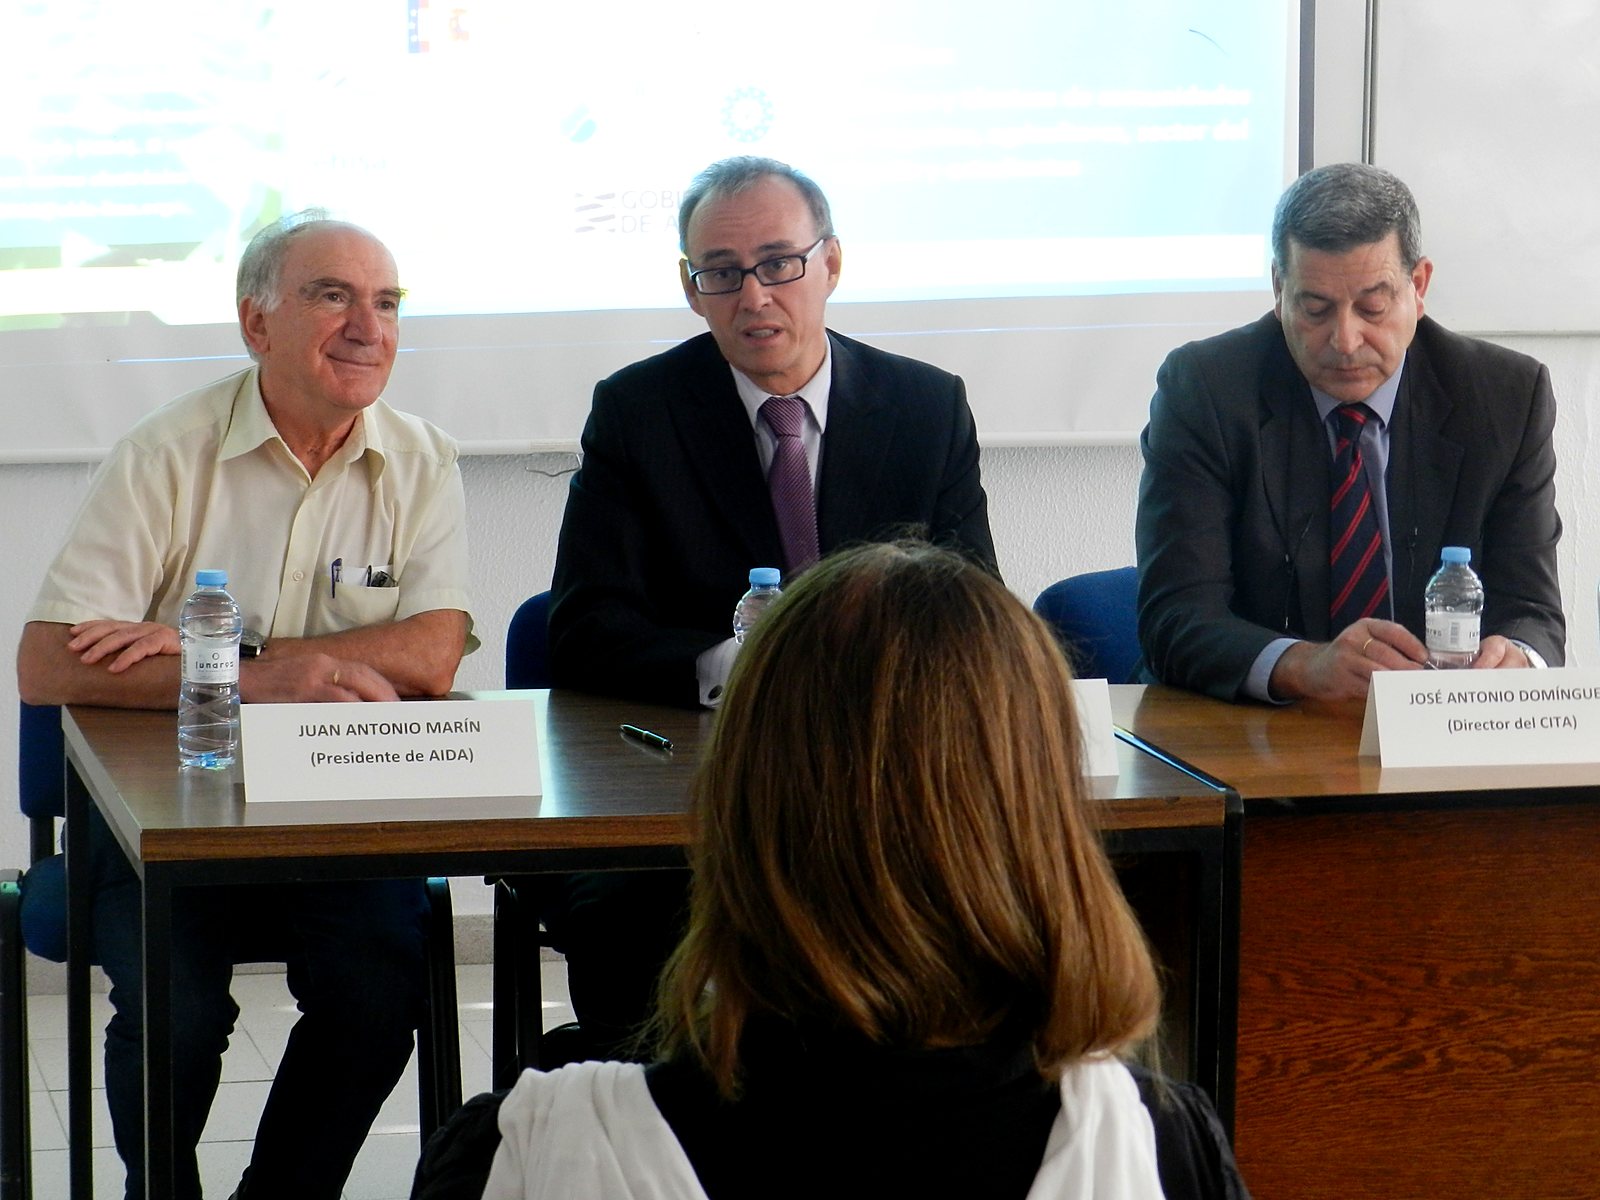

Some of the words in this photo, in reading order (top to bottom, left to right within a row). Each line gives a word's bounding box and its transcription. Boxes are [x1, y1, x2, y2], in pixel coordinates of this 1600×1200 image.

[623, 191, 682, 209] GOBI
[623, 215, 650, 233] DE
[1409, 689, 1443, 706] JOSÉ
[1447, 690, 1515, 705] ANTONIO
[299, 723, 341, 738] JUAN
[346, 721, 421, 737] ANTONIO
[426, 717, 481, 735] MARÍN
[1448, 717, 1510, 735] (Director
[1514, 716, 1536, 730] del
[1540, 714, 1577, 731] CITA)
[311, 750, 400, 768] (Presidente
[405, 749, 424, 763] de
[429, 747, 474, 764] AIDA)
